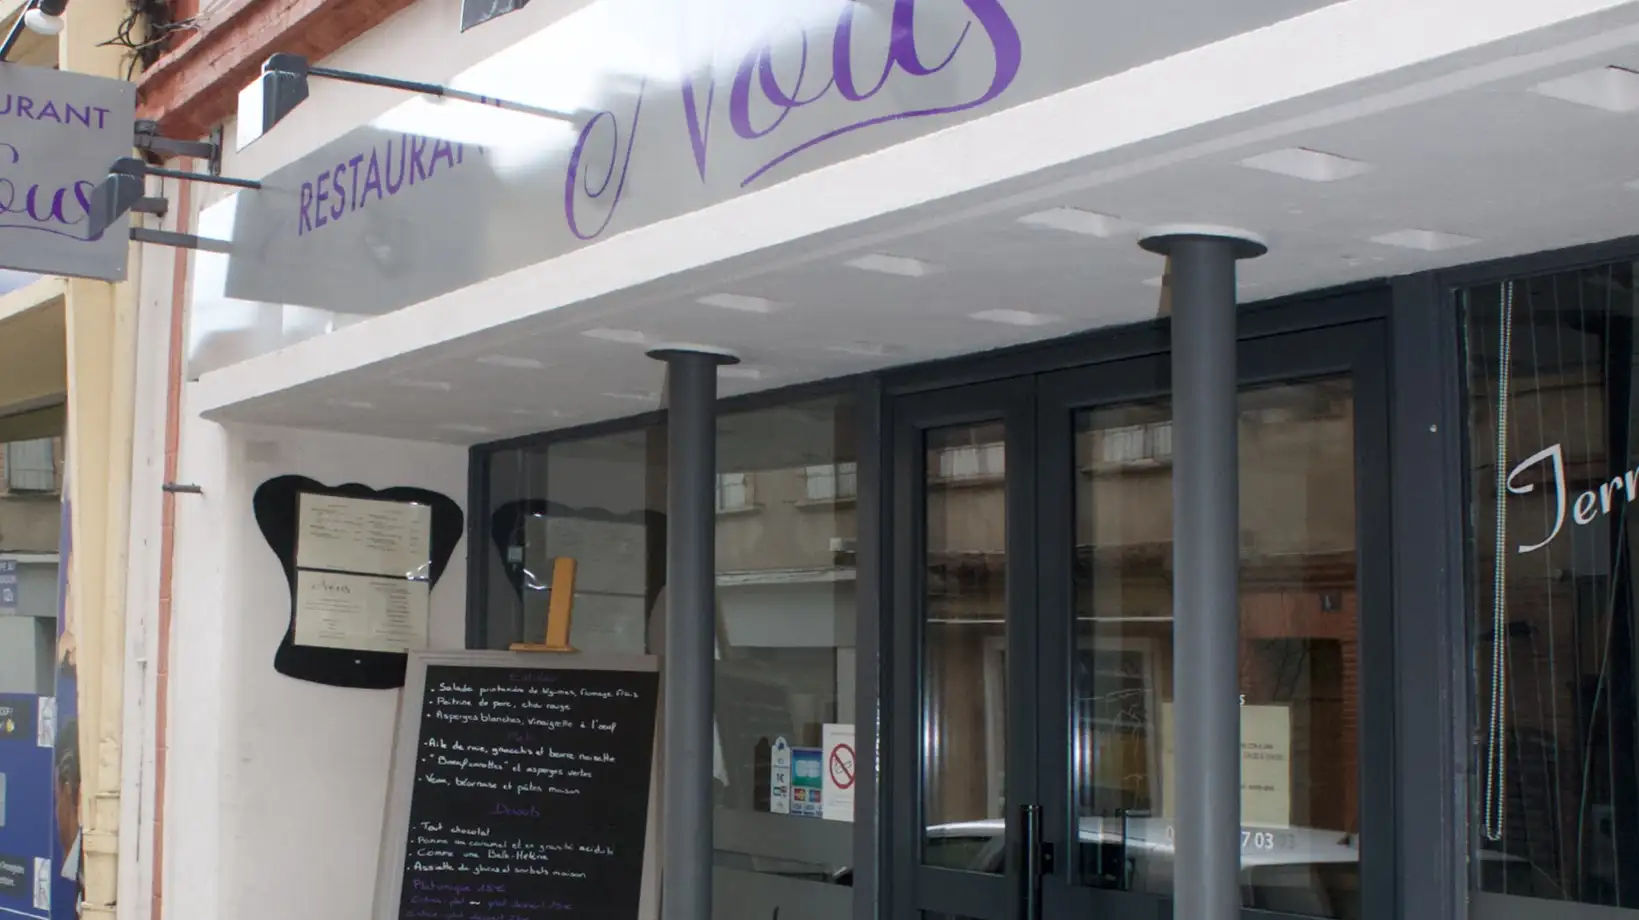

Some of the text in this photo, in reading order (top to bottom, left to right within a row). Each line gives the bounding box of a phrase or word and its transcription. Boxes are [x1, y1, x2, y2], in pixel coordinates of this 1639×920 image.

[439, 682, 473, 693] Salade
[437, 696, 472, 706] Poitrine
[478, 698, 489, 706] de
[546, 703, 571, 712] rouge
[436, 710, 478, 724] Asperges
[428, 737, 448, 749] Aile
[452, 740, 464, 750] de
[535, 746, 544, 756] et
[512, 763, 521, 773] et
[526, 767, 563, 778] asperges
[567, 768, 592, 778] vertes
[503, 780, 512, 790] et
[548, 786, 580, 795] maison
[420, 821, 491, 837] Tout chocolat
[469, 839, 508, 849] caramel
[511, 838, 521, 849] et
[1254, 832, 1274, 849] 03
[416, 848, 454, 858] Comme
[462, 850, 481, 859] une
[413, 860, 455, 872] Assiette
[552, 869, 587, 879] maison
